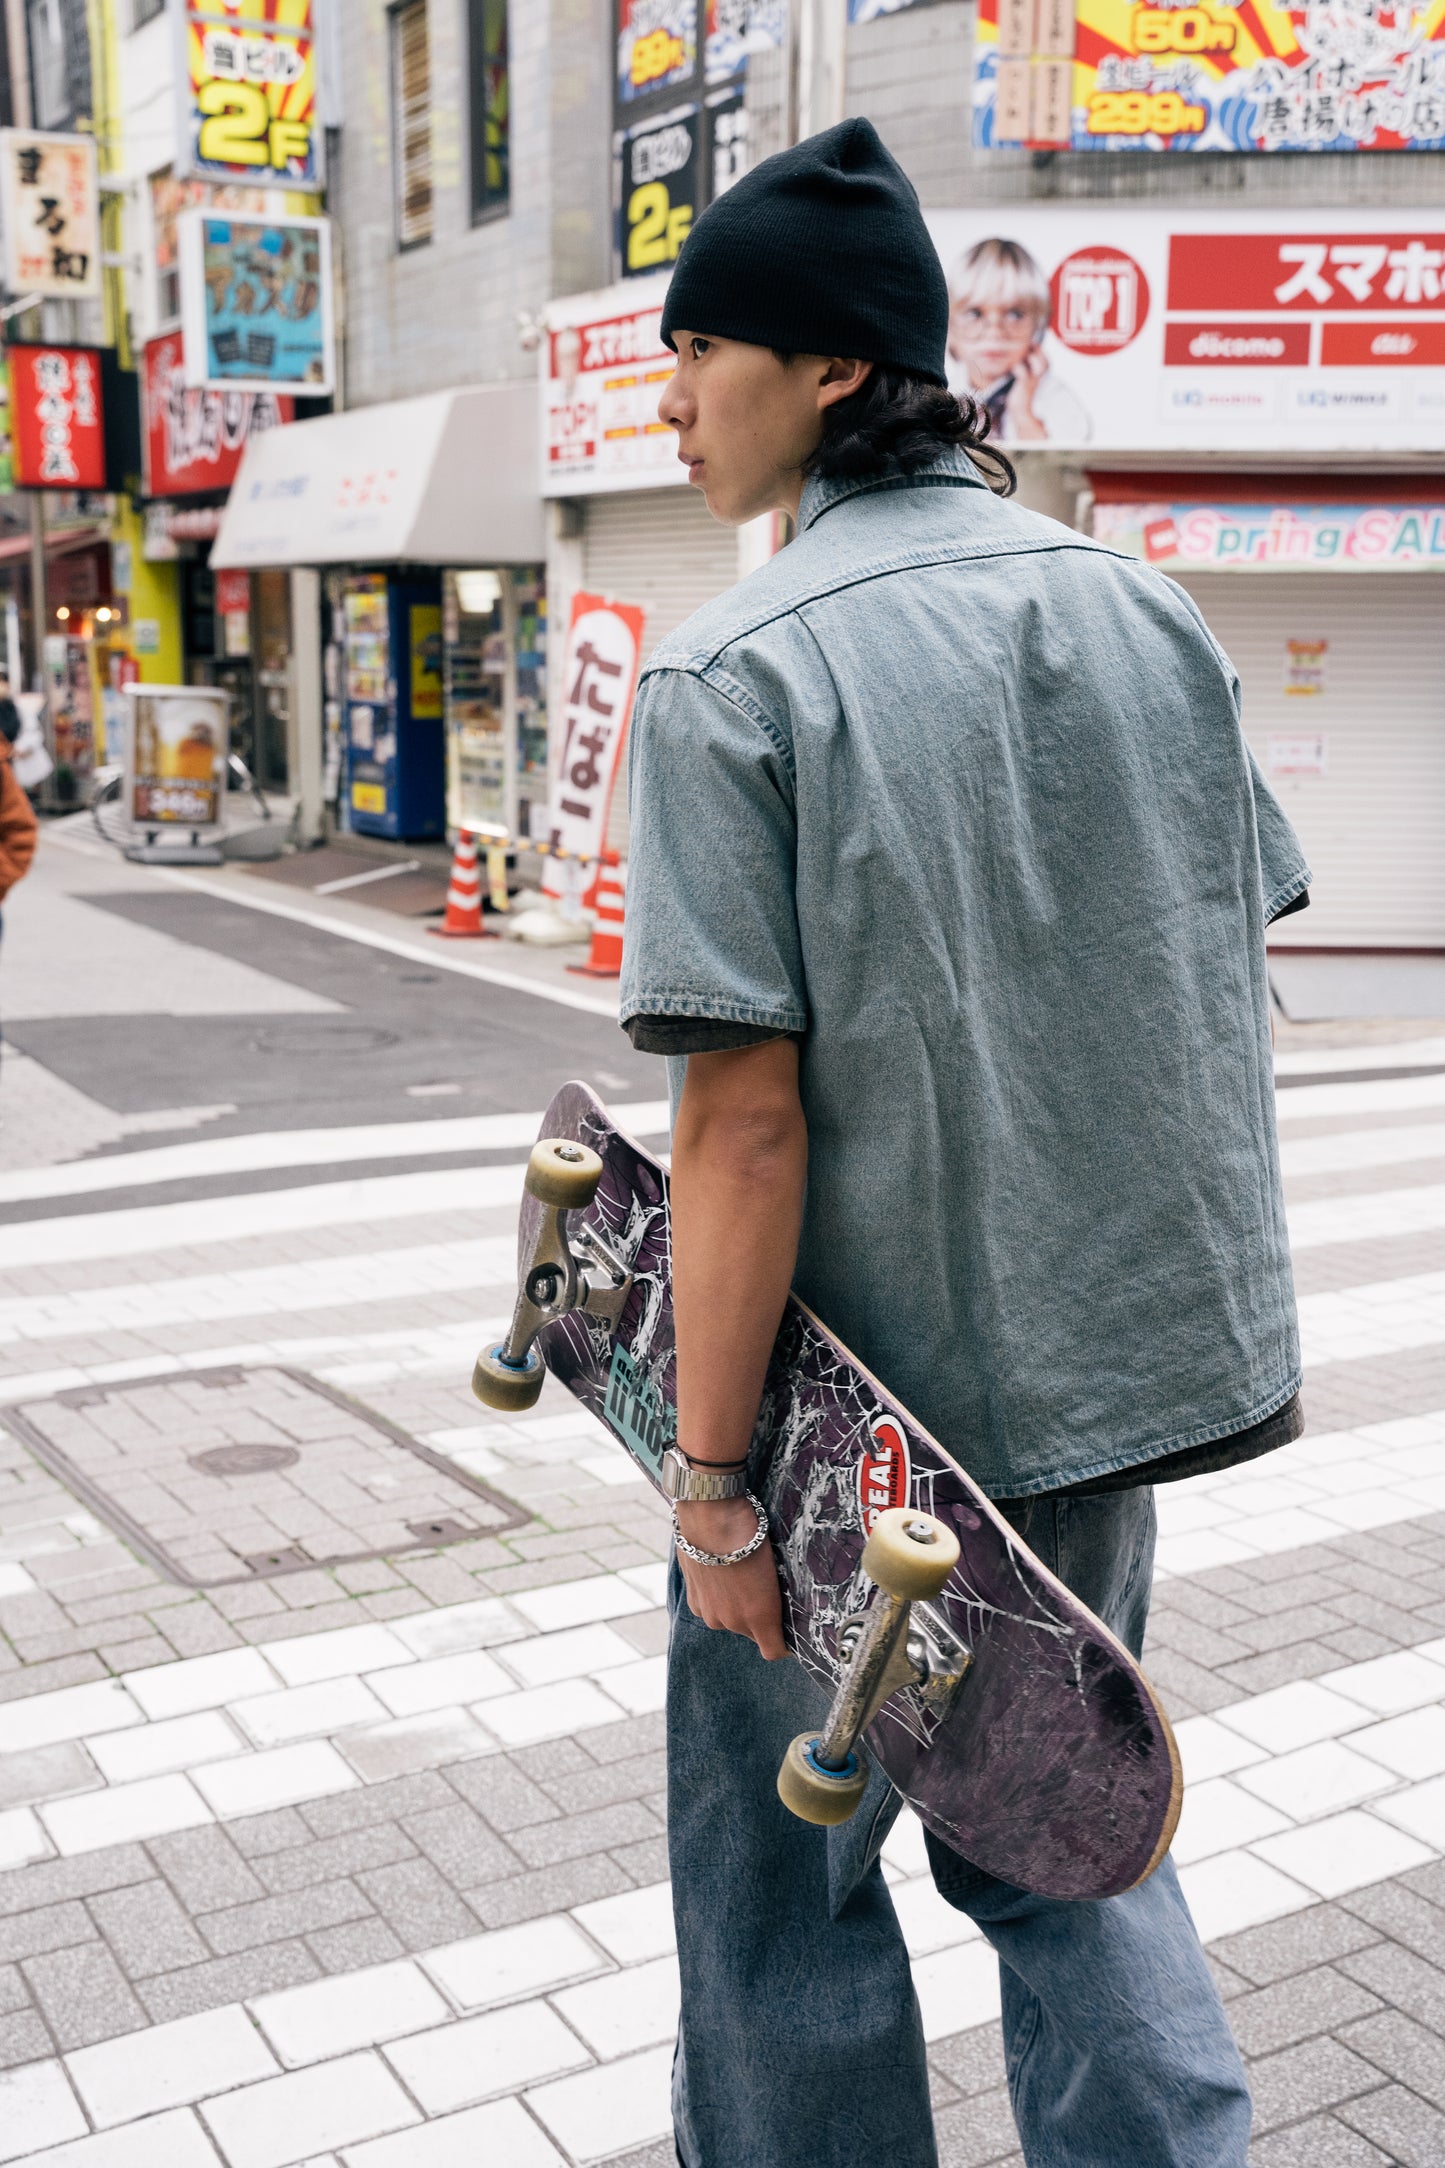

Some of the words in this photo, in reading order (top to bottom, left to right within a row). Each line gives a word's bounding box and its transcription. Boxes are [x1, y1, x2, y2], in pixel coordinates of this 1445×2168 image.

[201, 80, 310, 170] 2F
[629, 181, 693, 269] 2F
[1274, 241, 1445, 303] スマホ
[1189, 331, 1285, 358] docomo
[1187, 514, 1342, 560] Spring
